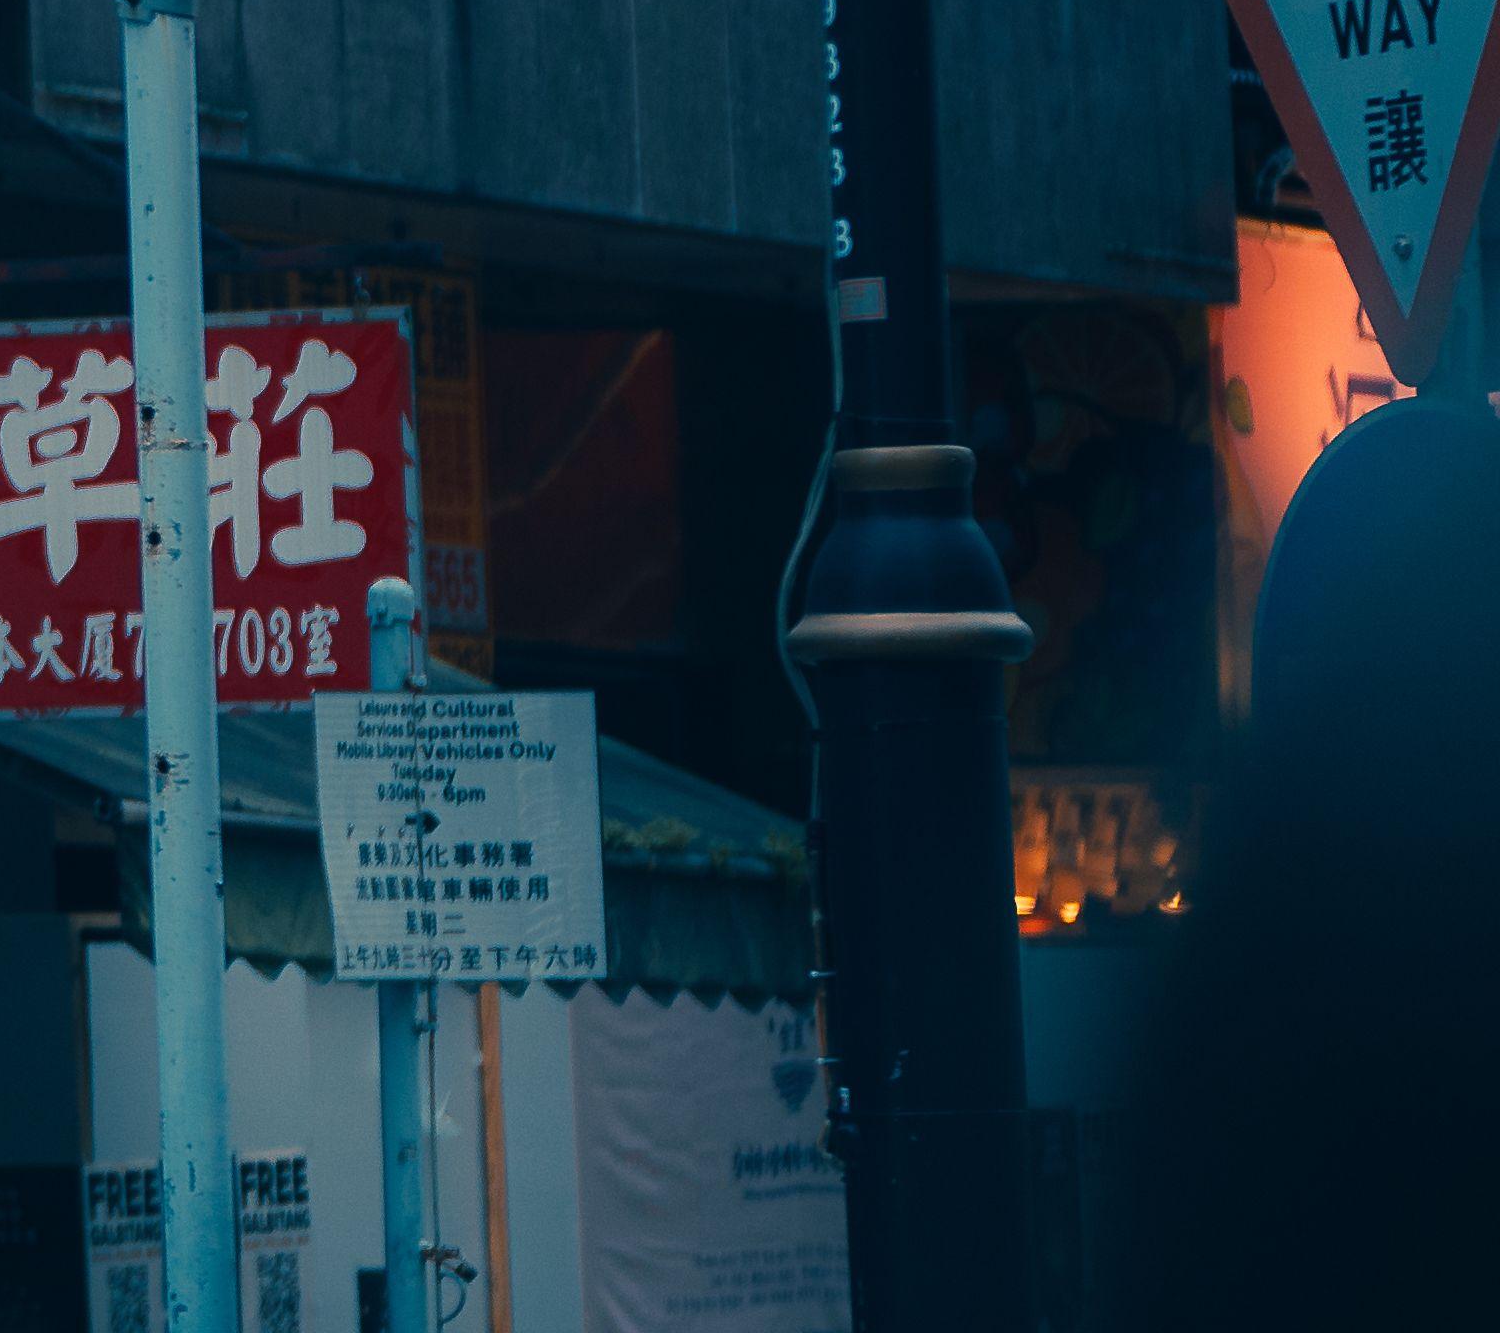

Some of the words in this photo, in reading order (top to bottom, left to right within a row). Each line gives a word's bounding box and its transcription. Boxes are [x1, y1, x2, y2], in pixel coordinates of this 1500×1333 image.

[1364, 90, 1430, 193] 讓
[432, 699, 515, 718] Cultural
[406, 720, 520, 741] Department
[422, 741, 504, 759] Vehicles
[509, 740, 557, 762] Only
[391, 761, 457, 783] Tuesday
[240, 1155, 309, 1206] FREE
[88, 1168, 163, 1220] FREE
